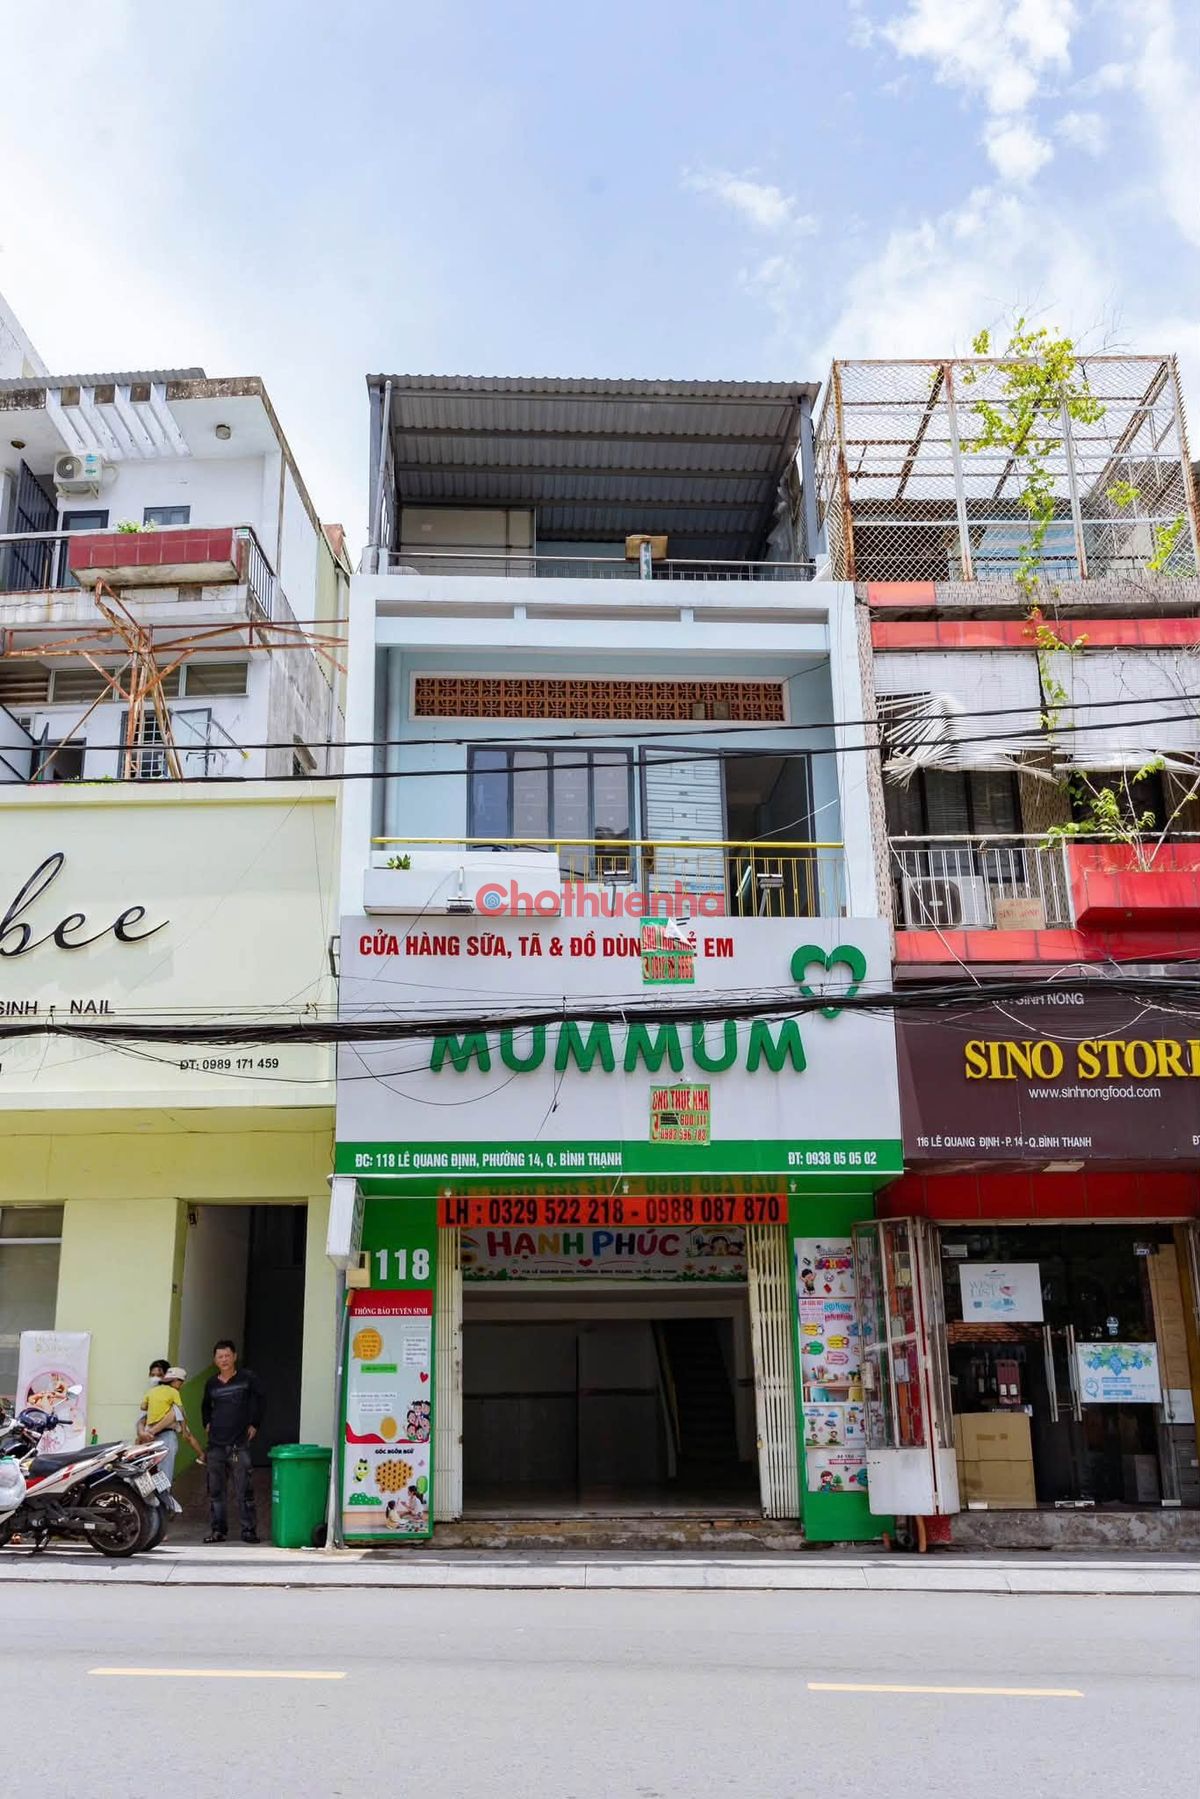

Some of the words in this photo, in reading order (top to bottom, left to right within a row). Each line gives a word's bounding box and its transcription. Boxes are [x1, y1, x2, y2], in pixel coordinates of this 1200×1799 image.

[359, 928, 400, 956] CỬA
[405, 931, 460, 956] HÀNG
[466, 932, 512, 959] SỮA,
[518, 932, 542, 956] TÃ
[549, 937, 563, 956] &
[570, 930, 596, 956] ĐỒ
[603, 933, 642, 957] DÙN
[704, 938, 734, 957] EM
[70, 1000, 115, 1014] NAIL
[430, 1019, 807, 1073] MUMMUM
[202, 1059, 231, 1069] 0989
[236, 1058, 253, 1069] 171
[257, 1058, 279, 1069] 459
[964, 1040, 1064, 1079] SINO
[1029, 1085, 1161, 1101] www.sinhnongfood.com
[916, 1137, 929, 1147] 116
[931, 1135, 942, 1147] LÊ
[944, 1137, 975, 1147] QUANG
[979, 1136, 1000, 1150] ĐỊNH
[355, 1153, 373, 1167] ĐC:
[376, 1153, 395, 1167] 118
[398, 1150, 410, 1167] LÊ
[413, 1153, 448, 1168] QUANG
[451, 1153, 480, 1170] ĐỊNH,
[482, 1150, 525, 1167] PHƯỜNG
[528, 1153, 544, 1168] 14,
[546, 1153, 557, 1168] Q.
[560, 1150, 585, 1167] BÌNH
[587, 1152, 622, 1169] THẠNH
[788, 1152, 803, 1165] ĐT:
[806, 1152, 830, 1165] 0938
[834, 1151, 846, 1165] 05
[849, 1151, 861, 1165] 05
[864, 1151, 877, 1165] 02
[445, 1199, 469, 1224] LH
[489, 1198, 537, 1224] 0329
[545, 1198, 581, 1224] 522
[588, 1198, 624, 1224] 218
[646, 1198, 694, 1223] 0988
[701, 1197, 736, 1222] 087
[744, 1196, 780, 1222] 870
[486, 1230, 584, 1260] HẠNH
[592, 1228, 680, 1257] PHÚC
[375, 1248, 430, 1280] 118
